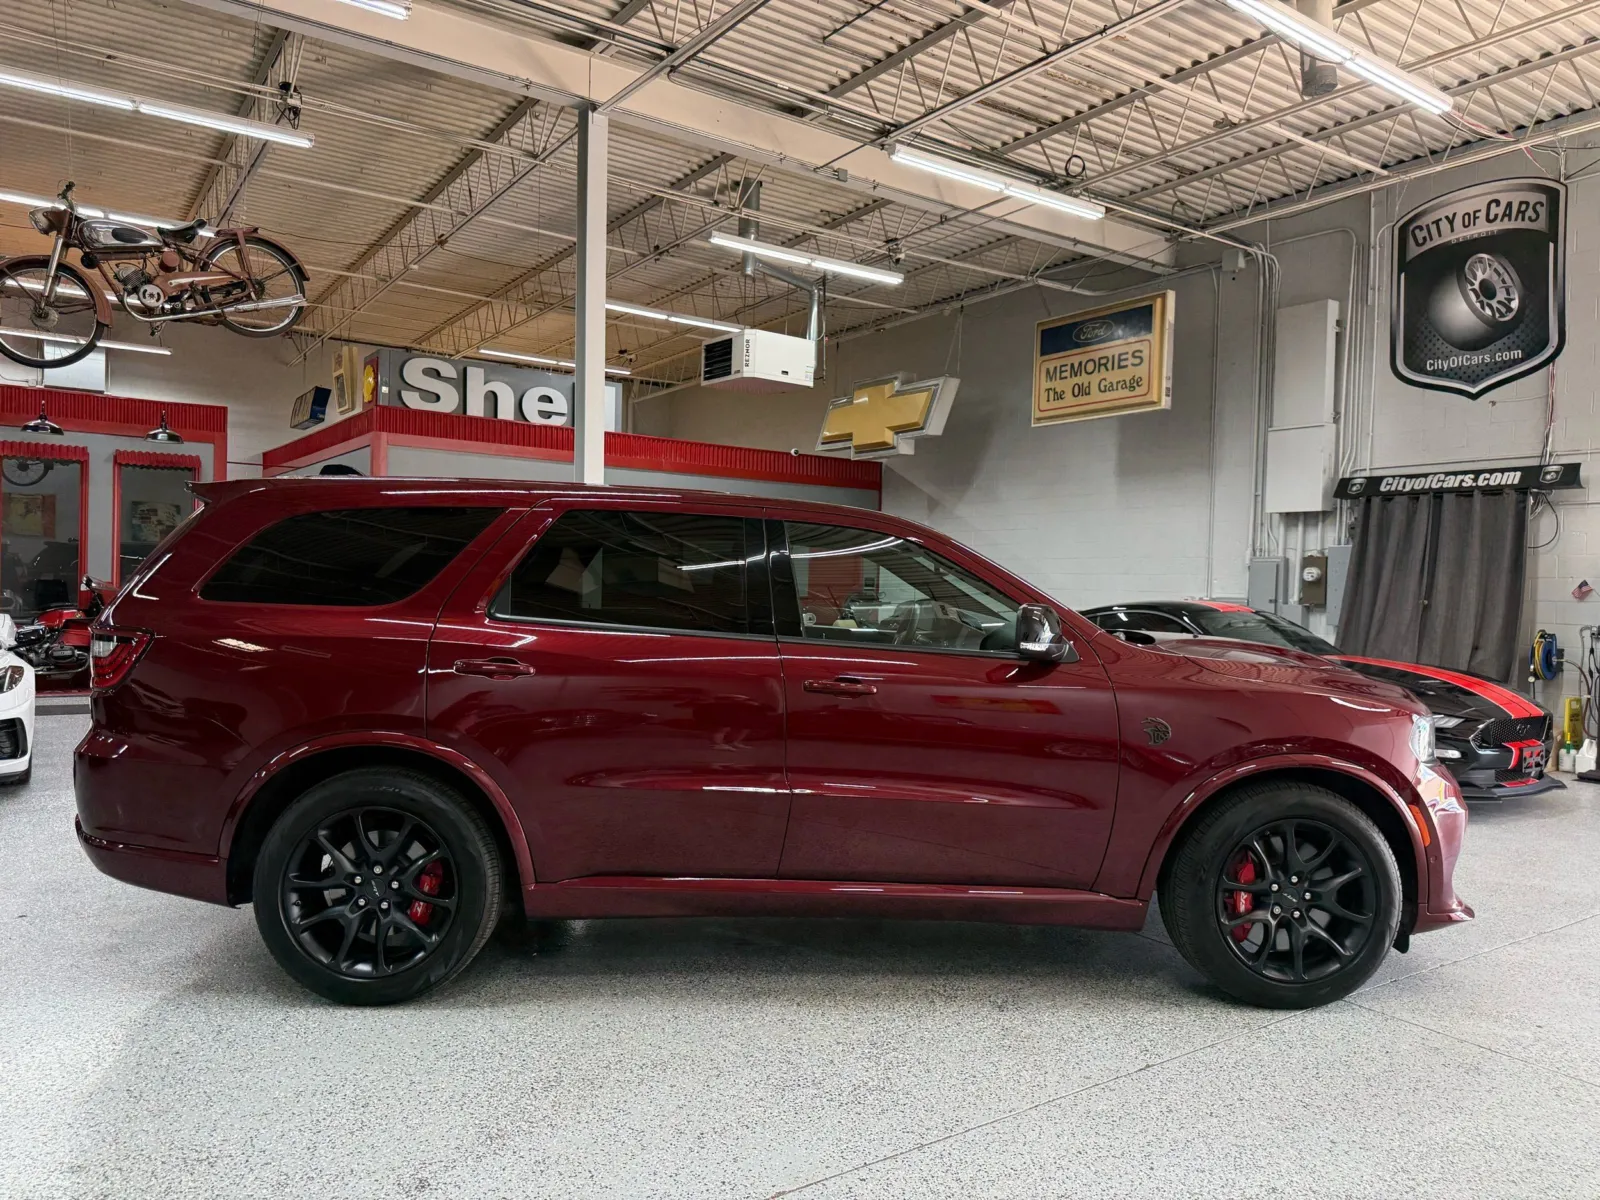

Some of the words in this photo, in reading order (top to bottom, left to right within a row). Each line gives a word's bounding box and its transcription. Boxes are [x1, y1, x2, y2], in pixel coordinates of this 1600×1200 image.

[1411, 212, 1456, 248] CITY
[1462, 209, 1482, 229] OF
[1485, 198, 1545, 224] CARS
[1451, 229, 1499, 244] DETROIT
[1080, 321, 1107, 340] Ford
[1045, 349, 1144, 384] MEMORIES
[1426, 349, 1522, 372] CityOfCars.com
[1045, 386, 1066, 403] The
[1071, 381, 1091, 398] Old
[1097, 374, 1143, 393] Garage
[1379, 469, 1522, 493] CityofCars.com
